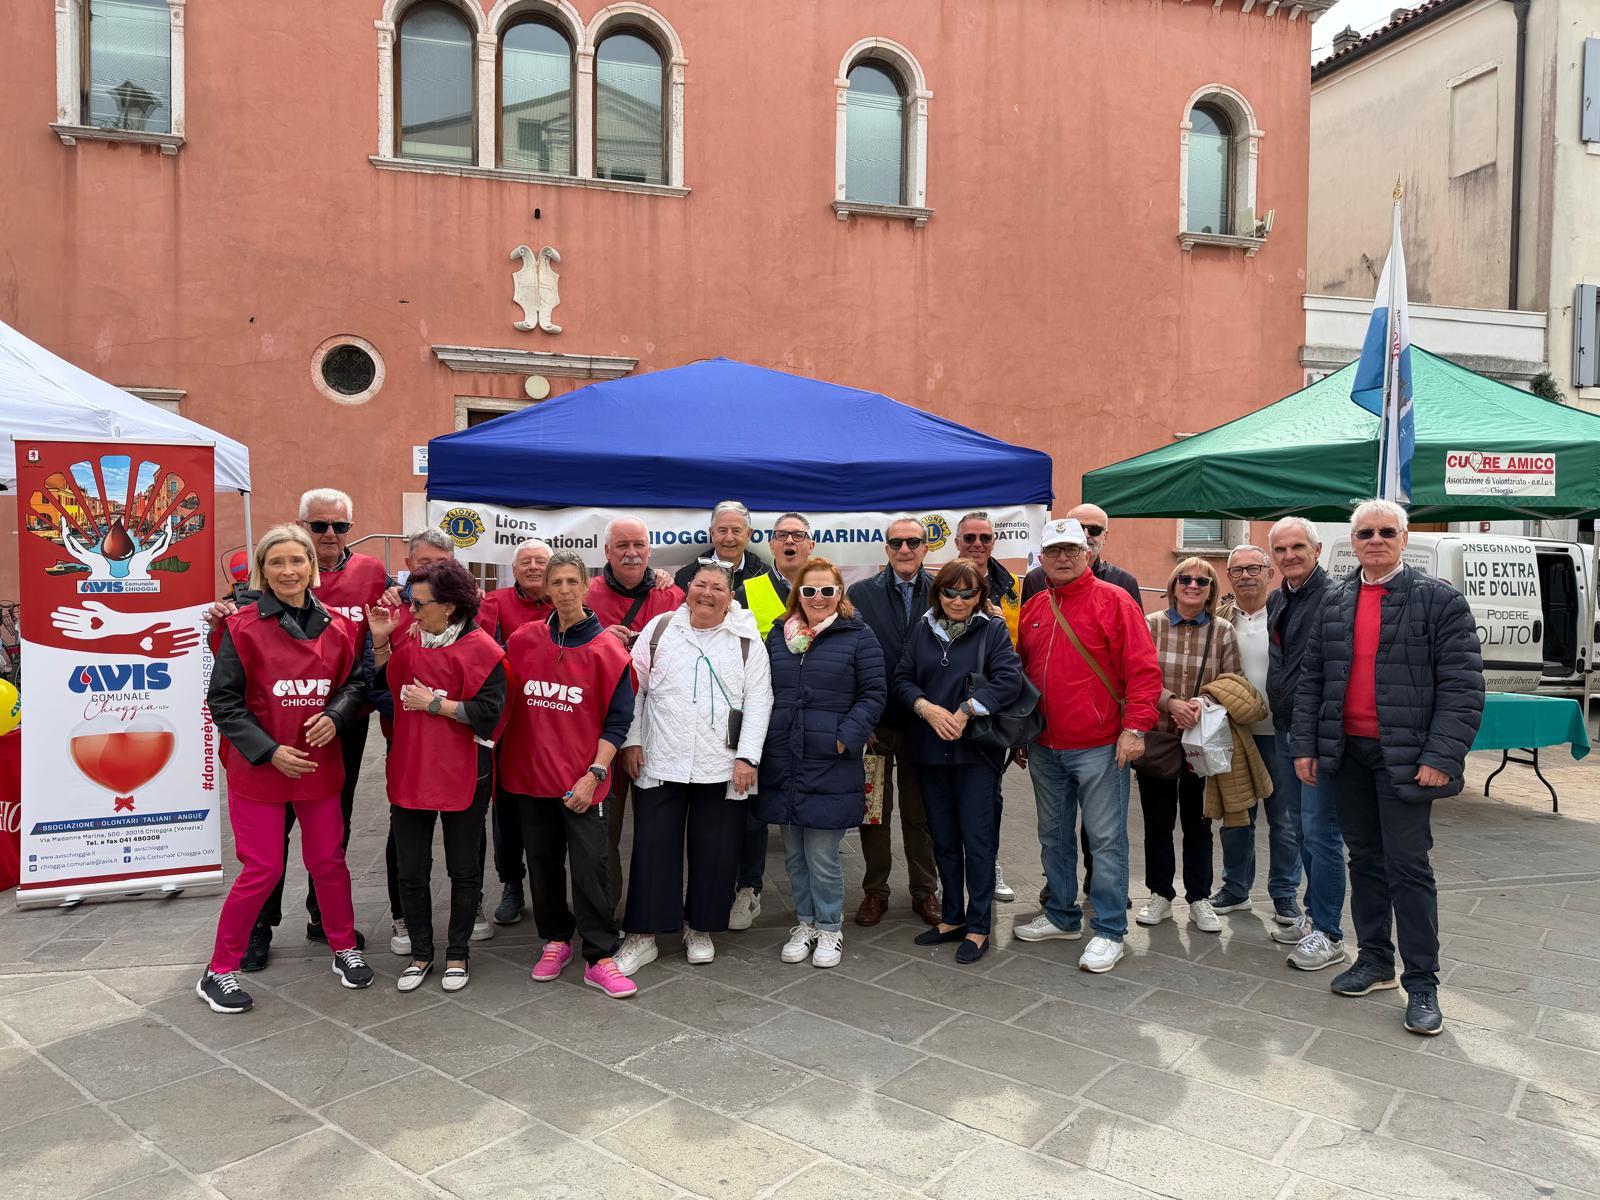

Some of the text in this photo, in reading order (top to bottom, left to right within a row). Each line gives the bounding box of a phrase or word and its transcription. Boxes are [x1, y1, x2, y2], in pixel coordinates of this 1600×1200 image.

[1507, 457, 1554, 469] AMICO
[1447, 476, 1484, 485] Associazione
[1485, 477, 1491, 485] di
[1492, 477, 1526, 486] Volontariato
[1490, 487, 1513, 496] Chioggia
[449, 509, 477, 519] LIONS
[458, 520, 469, 534] L
[495, 514, 537, 531] Lions
[929, 526, 938, 539] L
[494, 531, 598, 549] Inteational
[1463, 543, 1531, 553] ONSEGNANDO
[1465, 562, 1535, 578] LIO EXTRA
[80, 581, 124, 593] AVIS
[1490, 580, 1537, 597] D'OLIVA
[68, 662, 172, 694] AVIS
[91, 692, 151, 702] COMUNALE
[523, 679, 584, 704] AVIS
[83, 699, 158, 721] Chioggia
[526, 698, 574, 713] CHIOGGIA
[38, 812, 203, 831] SSOCIAZIONE OLONTARI TALIANI ANGUE
